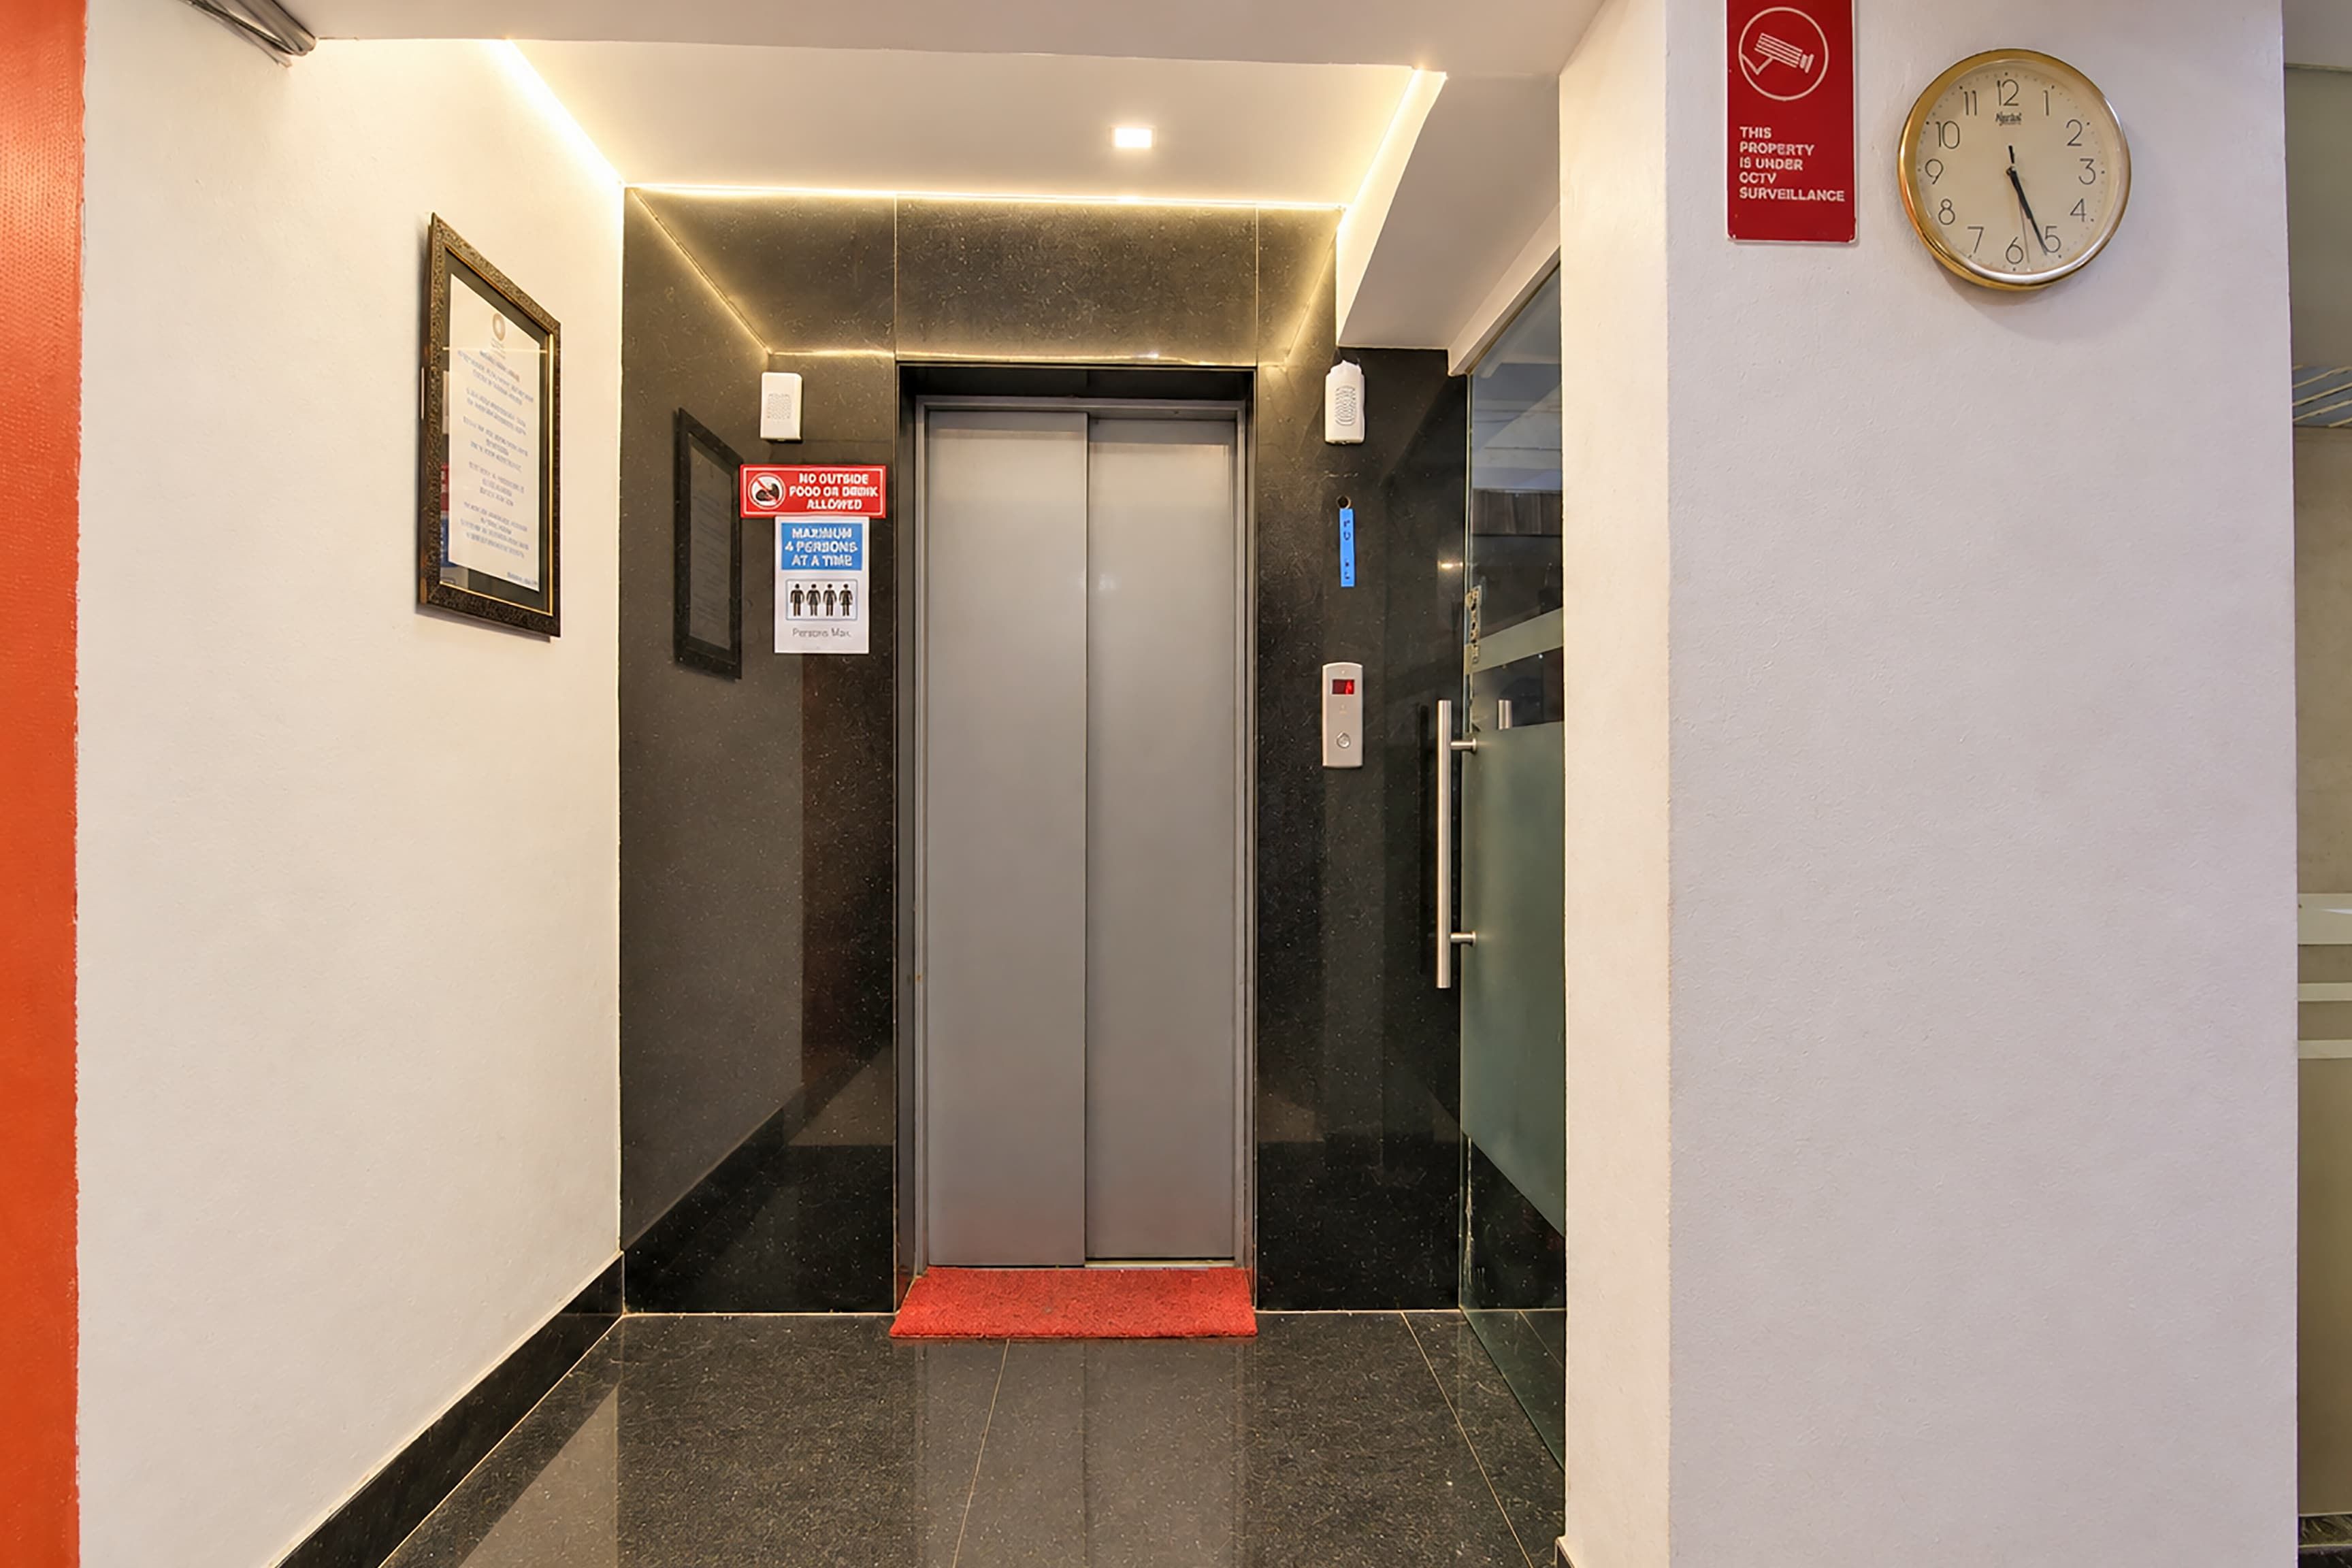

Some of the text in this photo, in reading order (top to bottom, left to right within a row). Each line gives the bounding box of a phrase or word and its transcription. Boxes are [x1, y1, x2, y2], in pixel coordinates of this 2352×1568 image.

[1963, 90, 1978, 116] 11
[1996, 78, 2019, 106] 12
[2042, 90, 2050, 116] 1
[1740, 126, 1772, 139] THIS
[1936, 120, 1961, 149] 10
[2065, 119, 2082, 146] 2
[1740, 141, 1815, 156] PROPERTY
[1740, 157, 1803, 171] IS UNDER
[1925, 159, 1944, 184] 9
[2078, 158, 2097, 185] 3
[1739, 172, 1776, 184] CCTV
[1739, 186, 1846, 202] SURVEILLANCE
[1938, 198, 1955, 225] 8
[2070, 197, 2087, 223] 4
[1967, 226, 1984, 253] 7
[2005, 236, 2024, 265] 6
[2044, 225, 2061, 253] 5
[789, 485, 821, 497] FOOD
[823, 486, 839, 497] OR
[798, 473, 869, 485] NO OUTSIDE
[806, 498, 863, 510] ALLOWED
[792, 527, 852, 539] MAXIMUM
[785, 540, 858, 553] 4 PERSONS
[791, 555, 853, 567] AT A TIME
